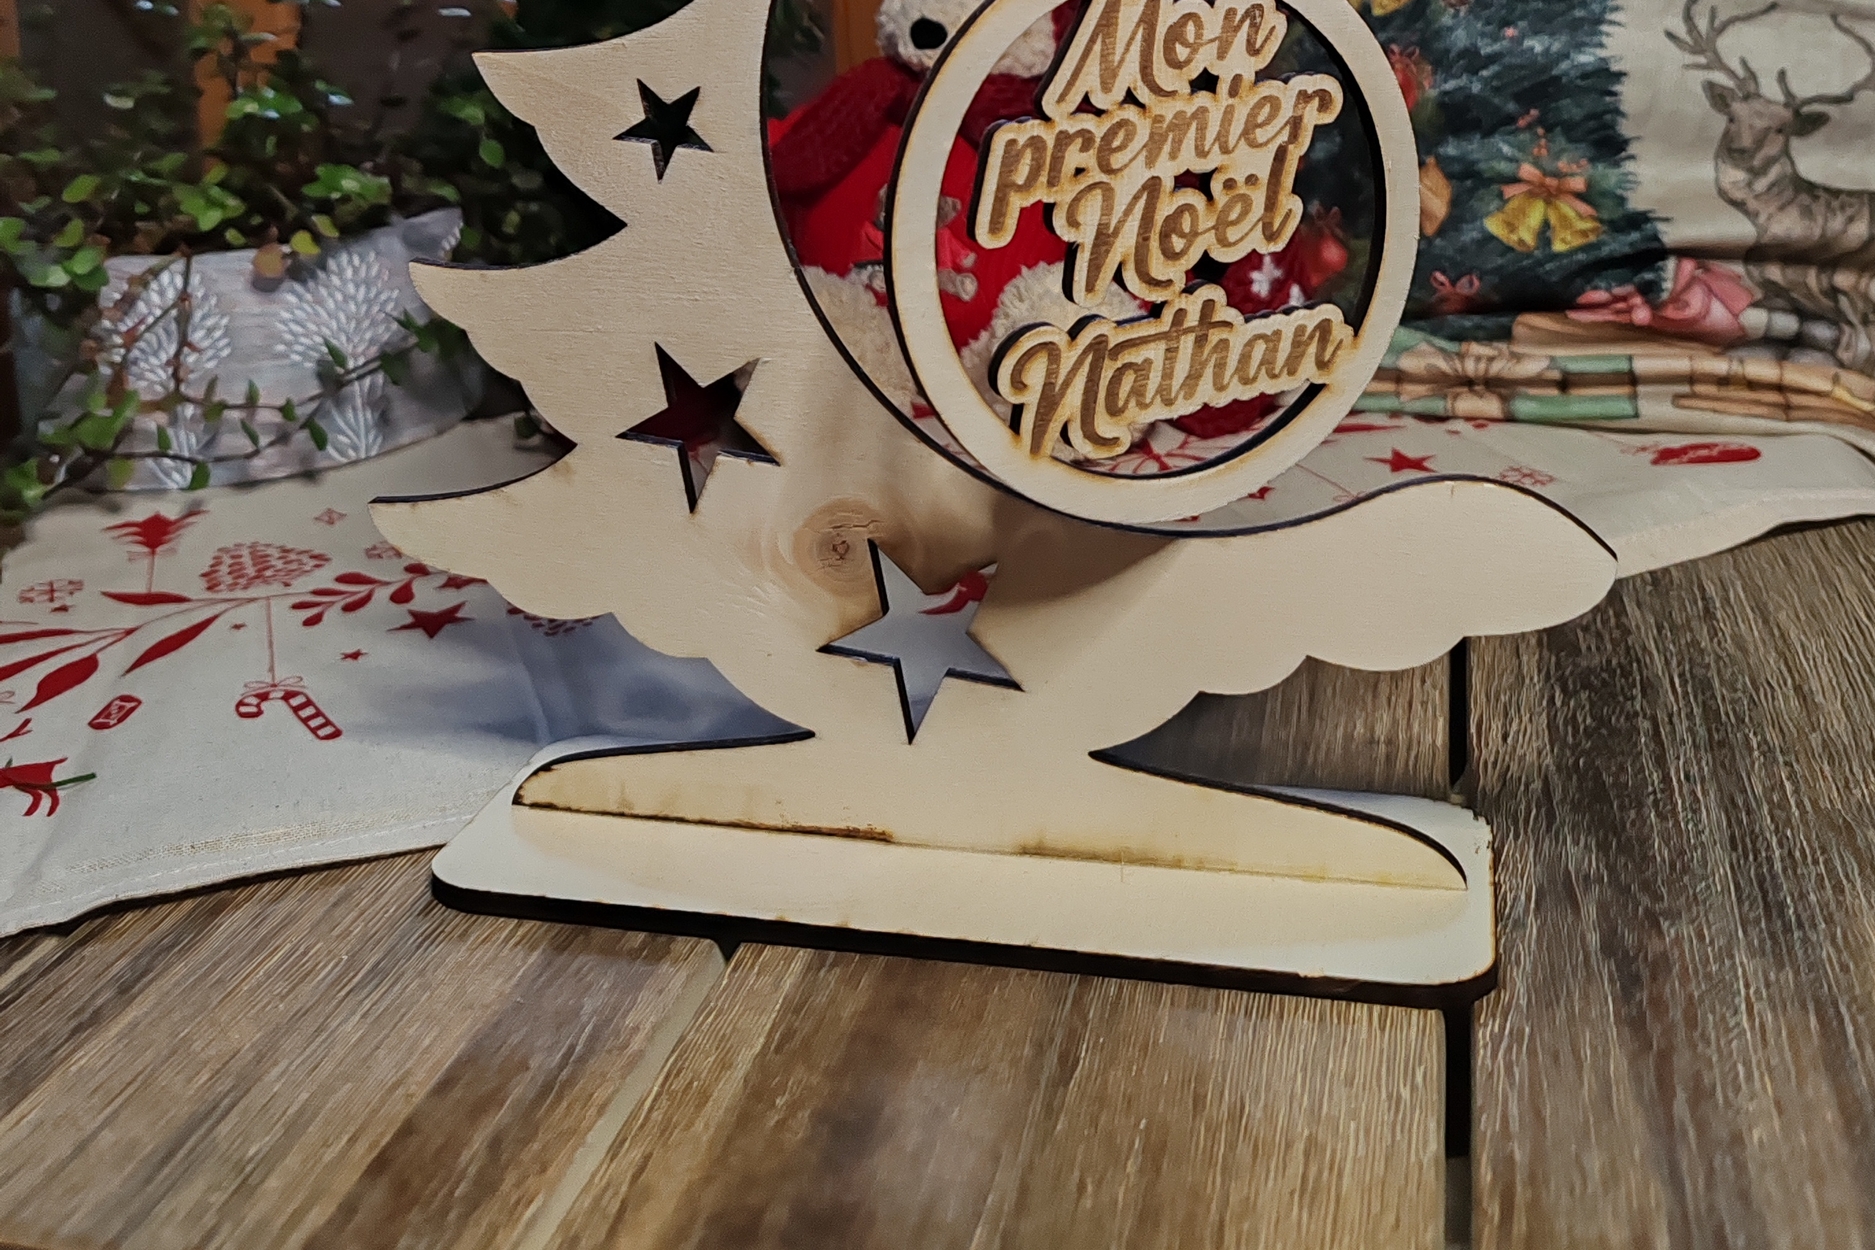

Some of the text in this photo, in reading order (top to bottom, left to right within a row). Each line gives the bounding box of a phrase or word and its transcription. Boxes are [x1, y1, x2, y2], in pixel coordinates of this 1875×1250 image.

[986, 73, 1333, 237] premier
[1066, 142, 1293, 296] Noël
[1009, 298, 1343, 456] Nathan
